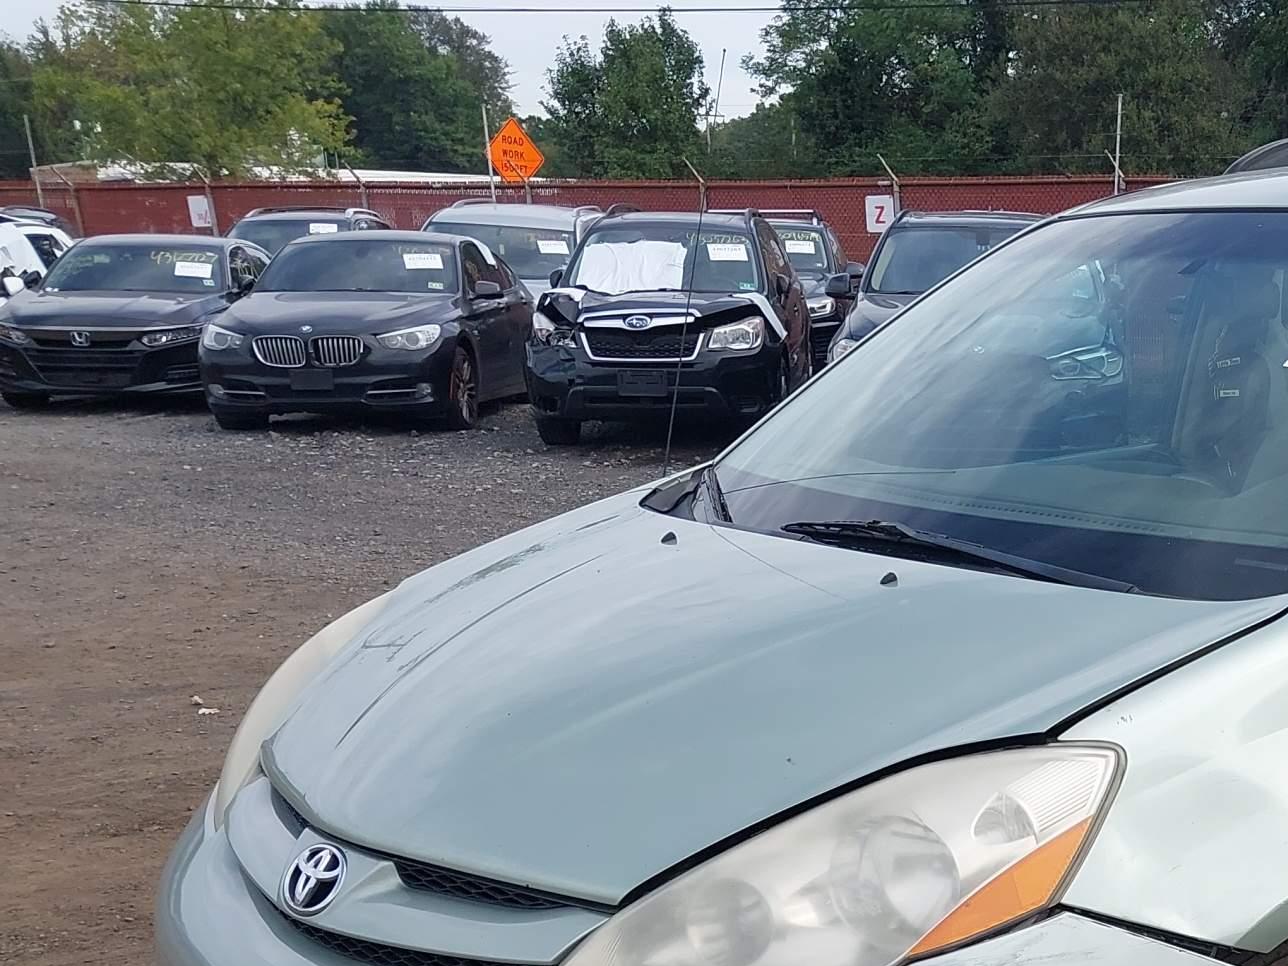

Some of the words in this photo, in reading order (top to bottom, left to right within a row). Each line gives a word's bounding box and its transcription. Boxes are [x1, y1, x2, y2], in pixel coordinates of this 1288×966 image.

[502, 135, 524, 146] ROAD
[502, 149, 525, 160] WORK
[874, 205, 886, 224] Z
